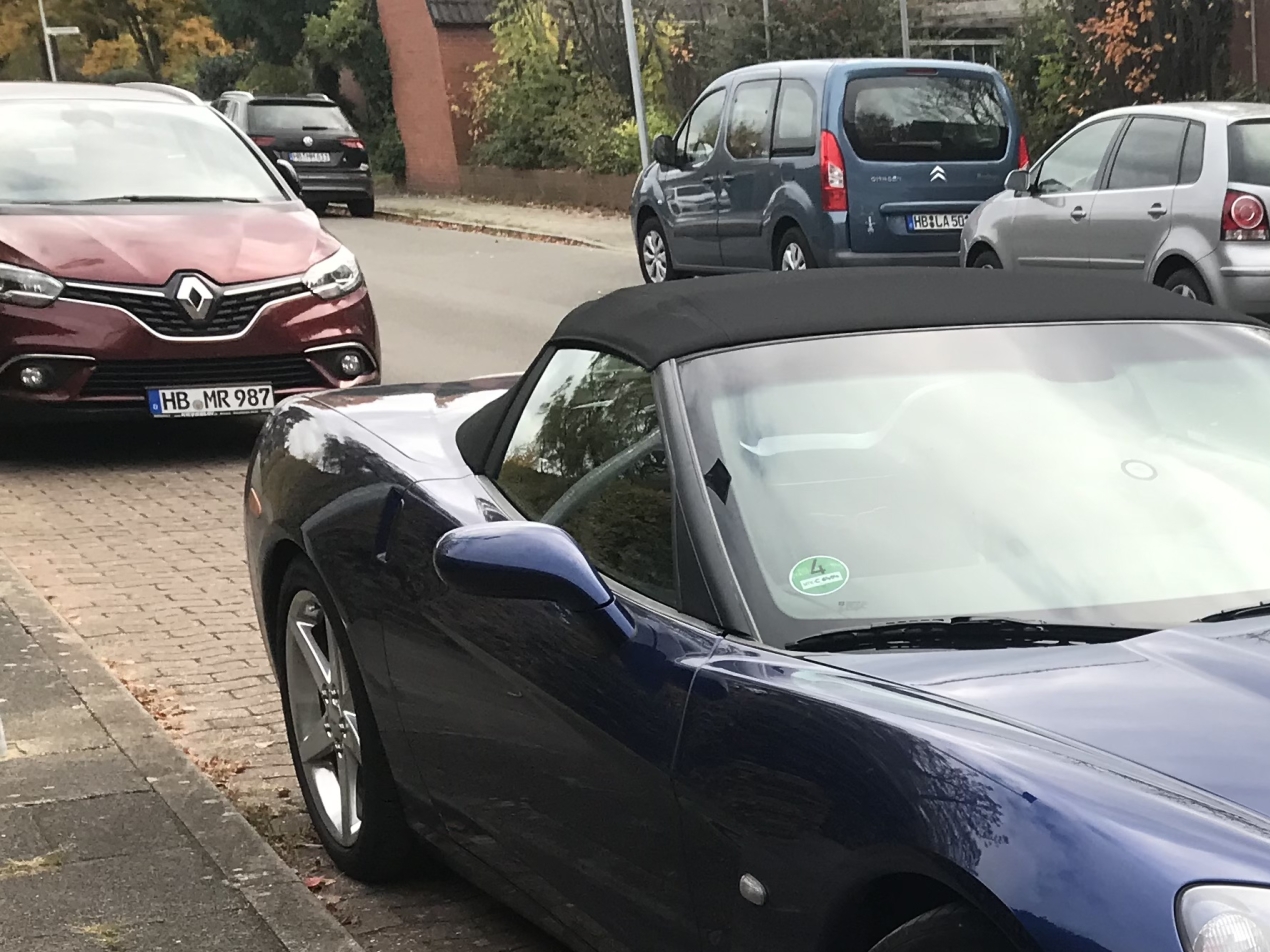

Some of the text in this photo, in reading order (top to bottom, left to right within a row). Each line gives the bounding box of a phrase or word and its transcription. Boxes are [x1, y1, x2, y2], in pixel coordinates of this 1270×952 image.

[913, 214, 928, 228] HB
[934, 214, 949, 228] LA
[161, 391, 190, 411] HB
[203, 389, 231, 409] MR
[234, 387, 270, 407] 987
[810, 558, 826, 575] 4
